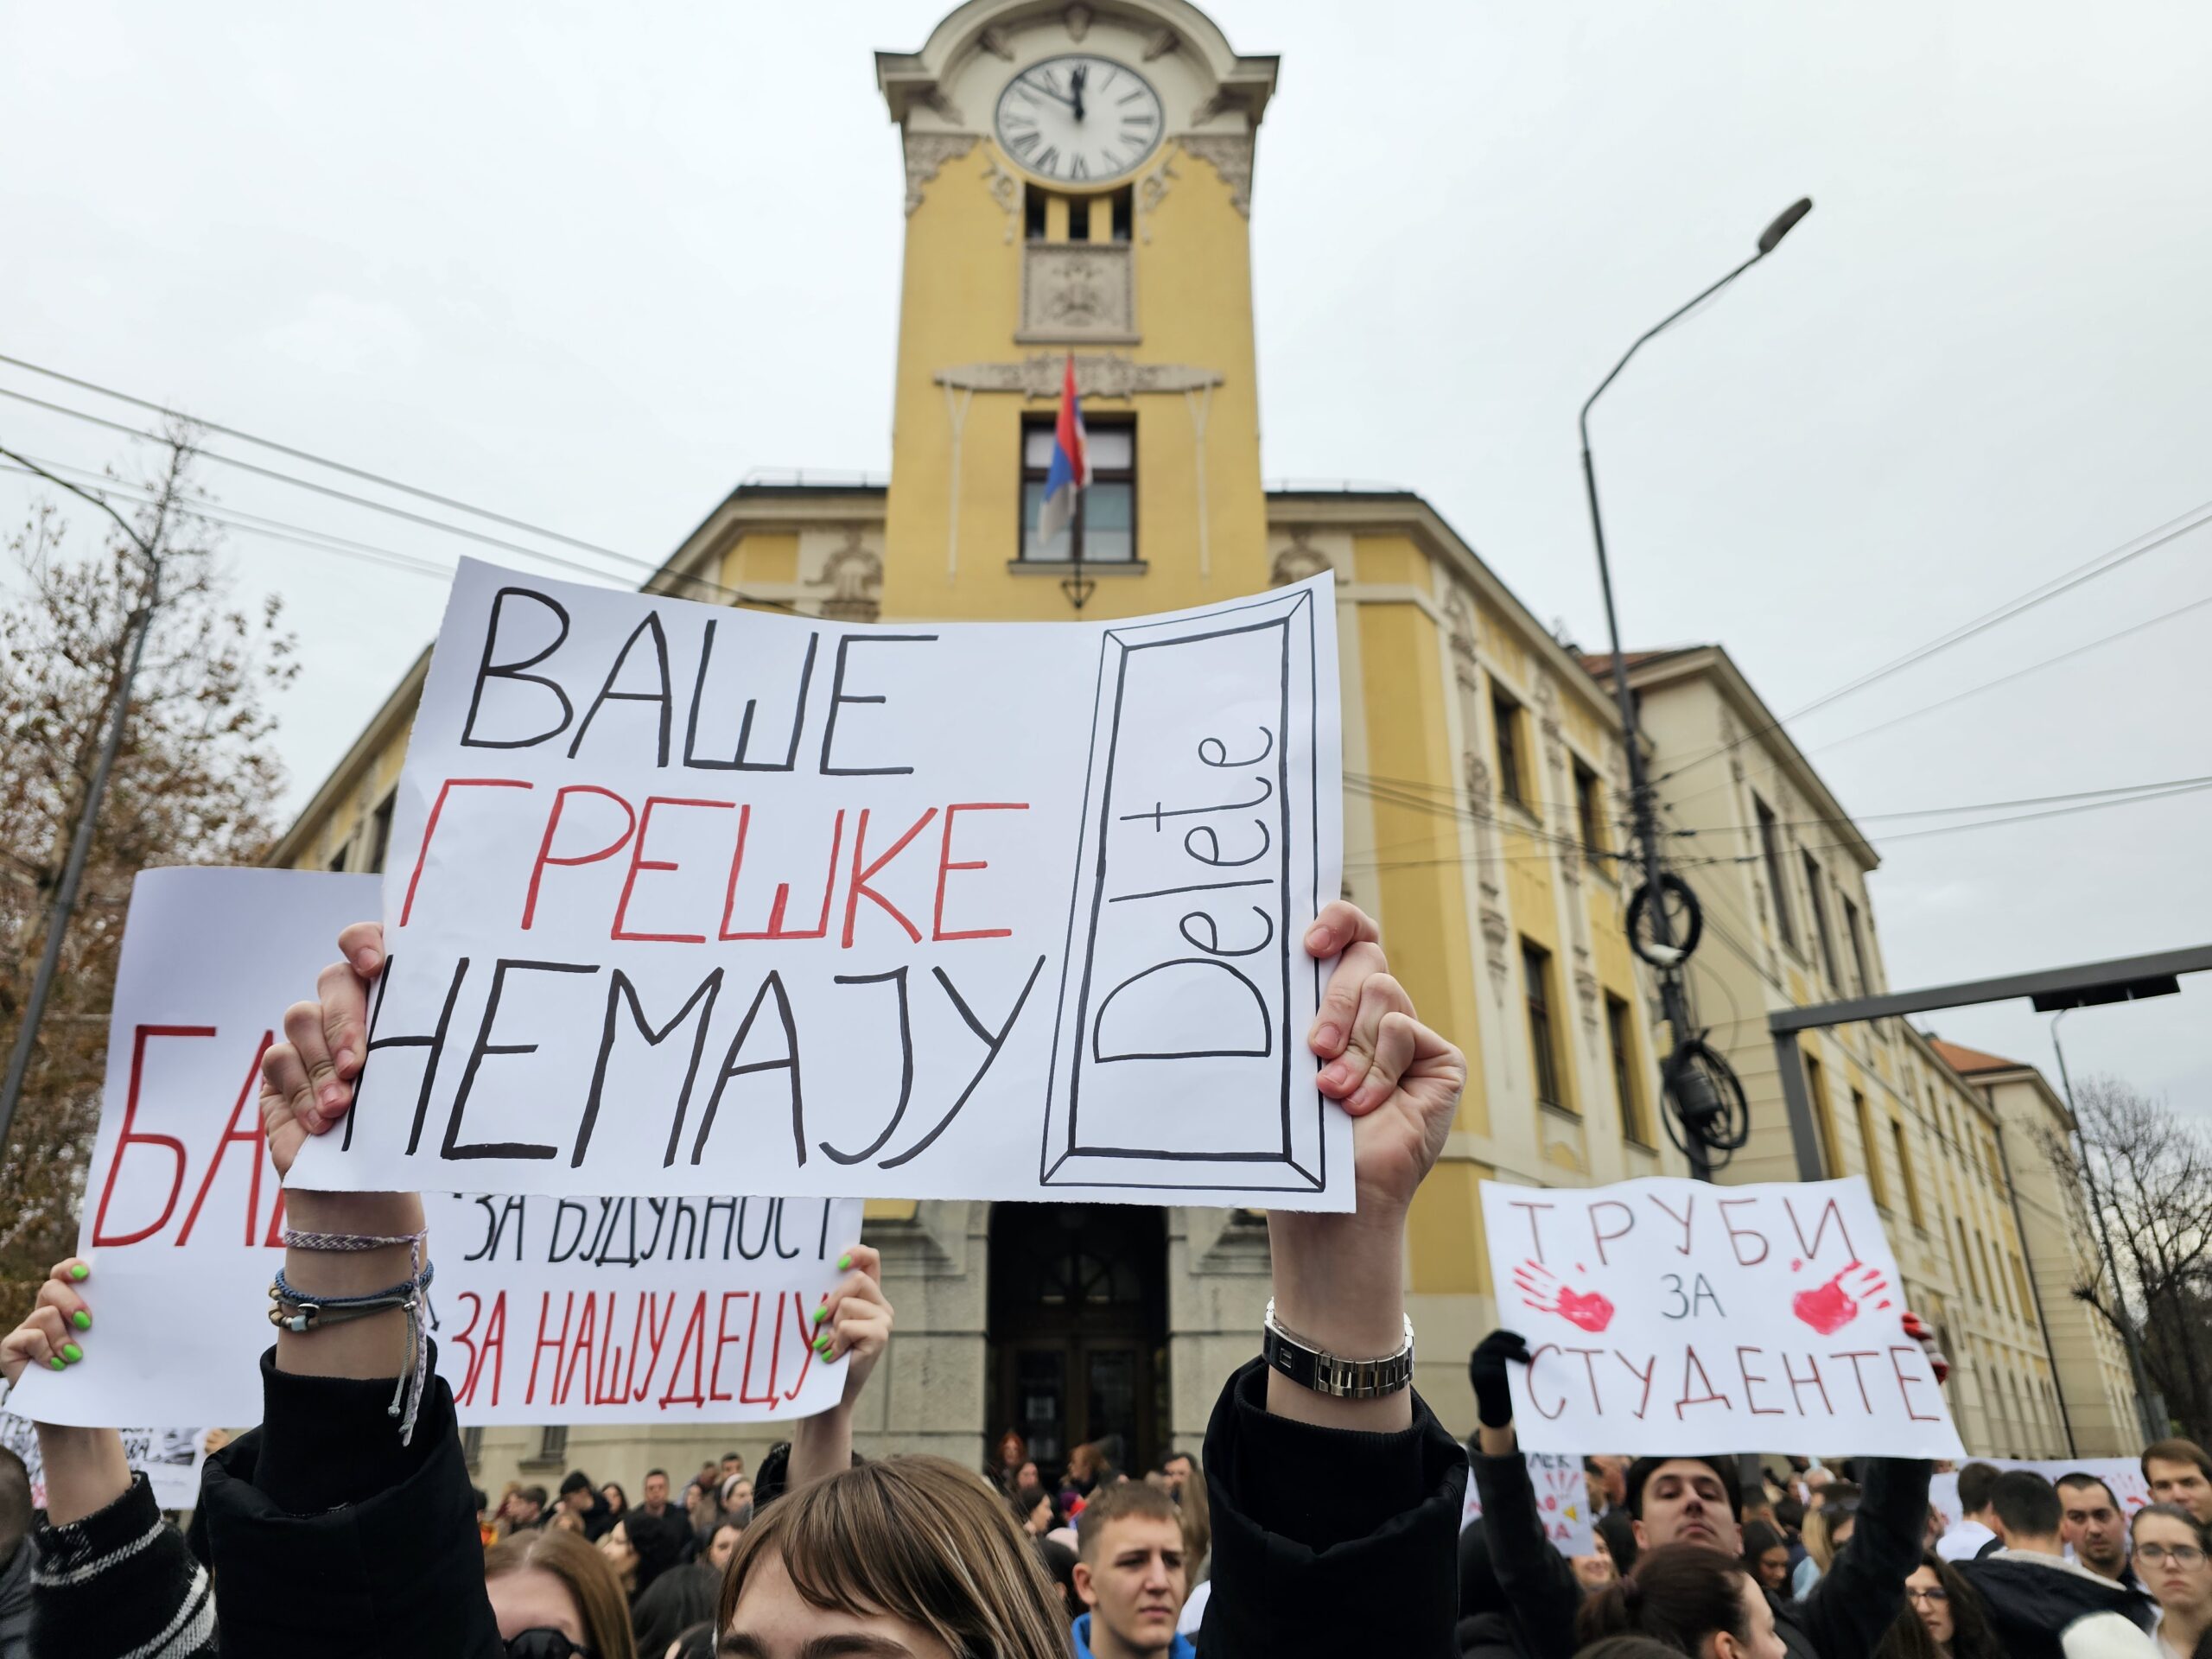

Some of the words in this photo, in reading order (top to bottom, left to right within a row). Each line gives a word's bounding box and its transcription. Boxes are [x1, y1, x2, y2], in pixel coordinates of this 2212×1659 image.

[461, 587, 939, 776] ВАШЕ
[400, 779, 1030, 950] ГРЕШКЕ
[1092, 724, 1275, 1064] Delete
[92, 1024, 287, 1249] БА
[344, 955, 1046, 1171] НЕМАЈУ
[1509, 1193, 1858, 1266] ТРУБИ
[1661, 1272, 1726, 1319] ЗА
[452, 1289, 506, 1407] ЗА
[1526, 1343, 1942, 1422] СТУДЕНТЕ
